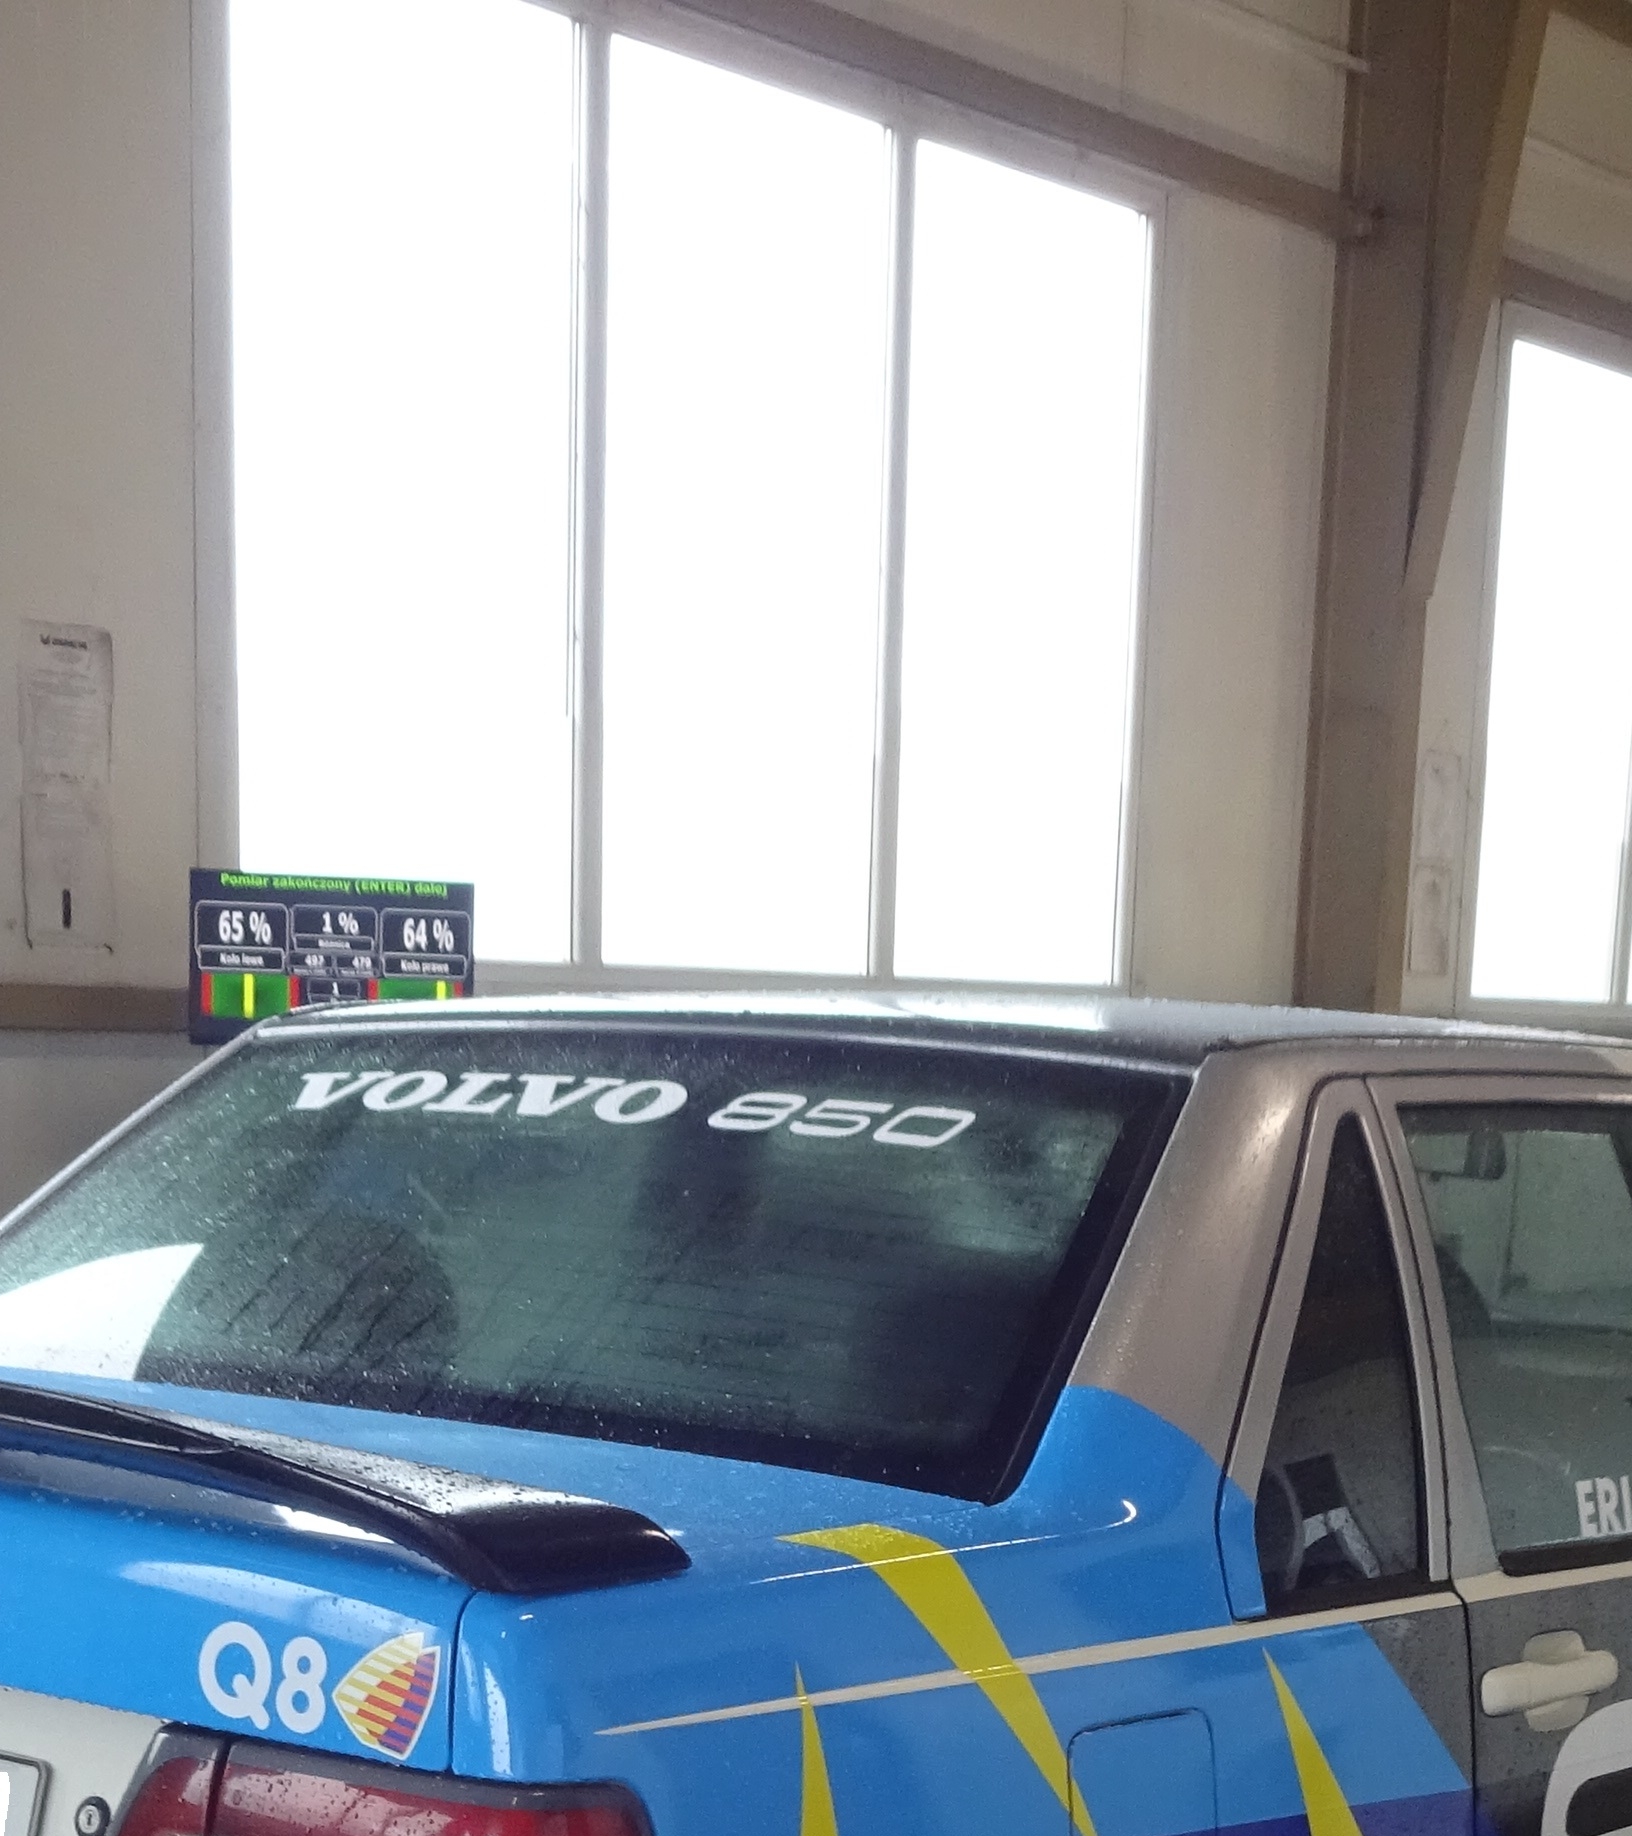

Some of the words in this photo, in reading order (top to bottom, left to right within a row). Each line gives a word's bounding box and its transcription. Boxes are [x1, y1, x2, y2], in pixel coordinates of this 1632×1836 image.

[220, 871, 269, 889] Pomiar
[218, 909, 244, 944] 65
[249, 910, 273, 946] %
[322, 911, 333, 935] 1
[338, 911, 360, 937] %
[403, 917, 428, 952] 64
[432, 918, 455, 954] %
[294, 1070, 687, 1124] VOLVO
[707, 1092, 976, 1147] 850
[198, 1621, 327, 1734] Q8
